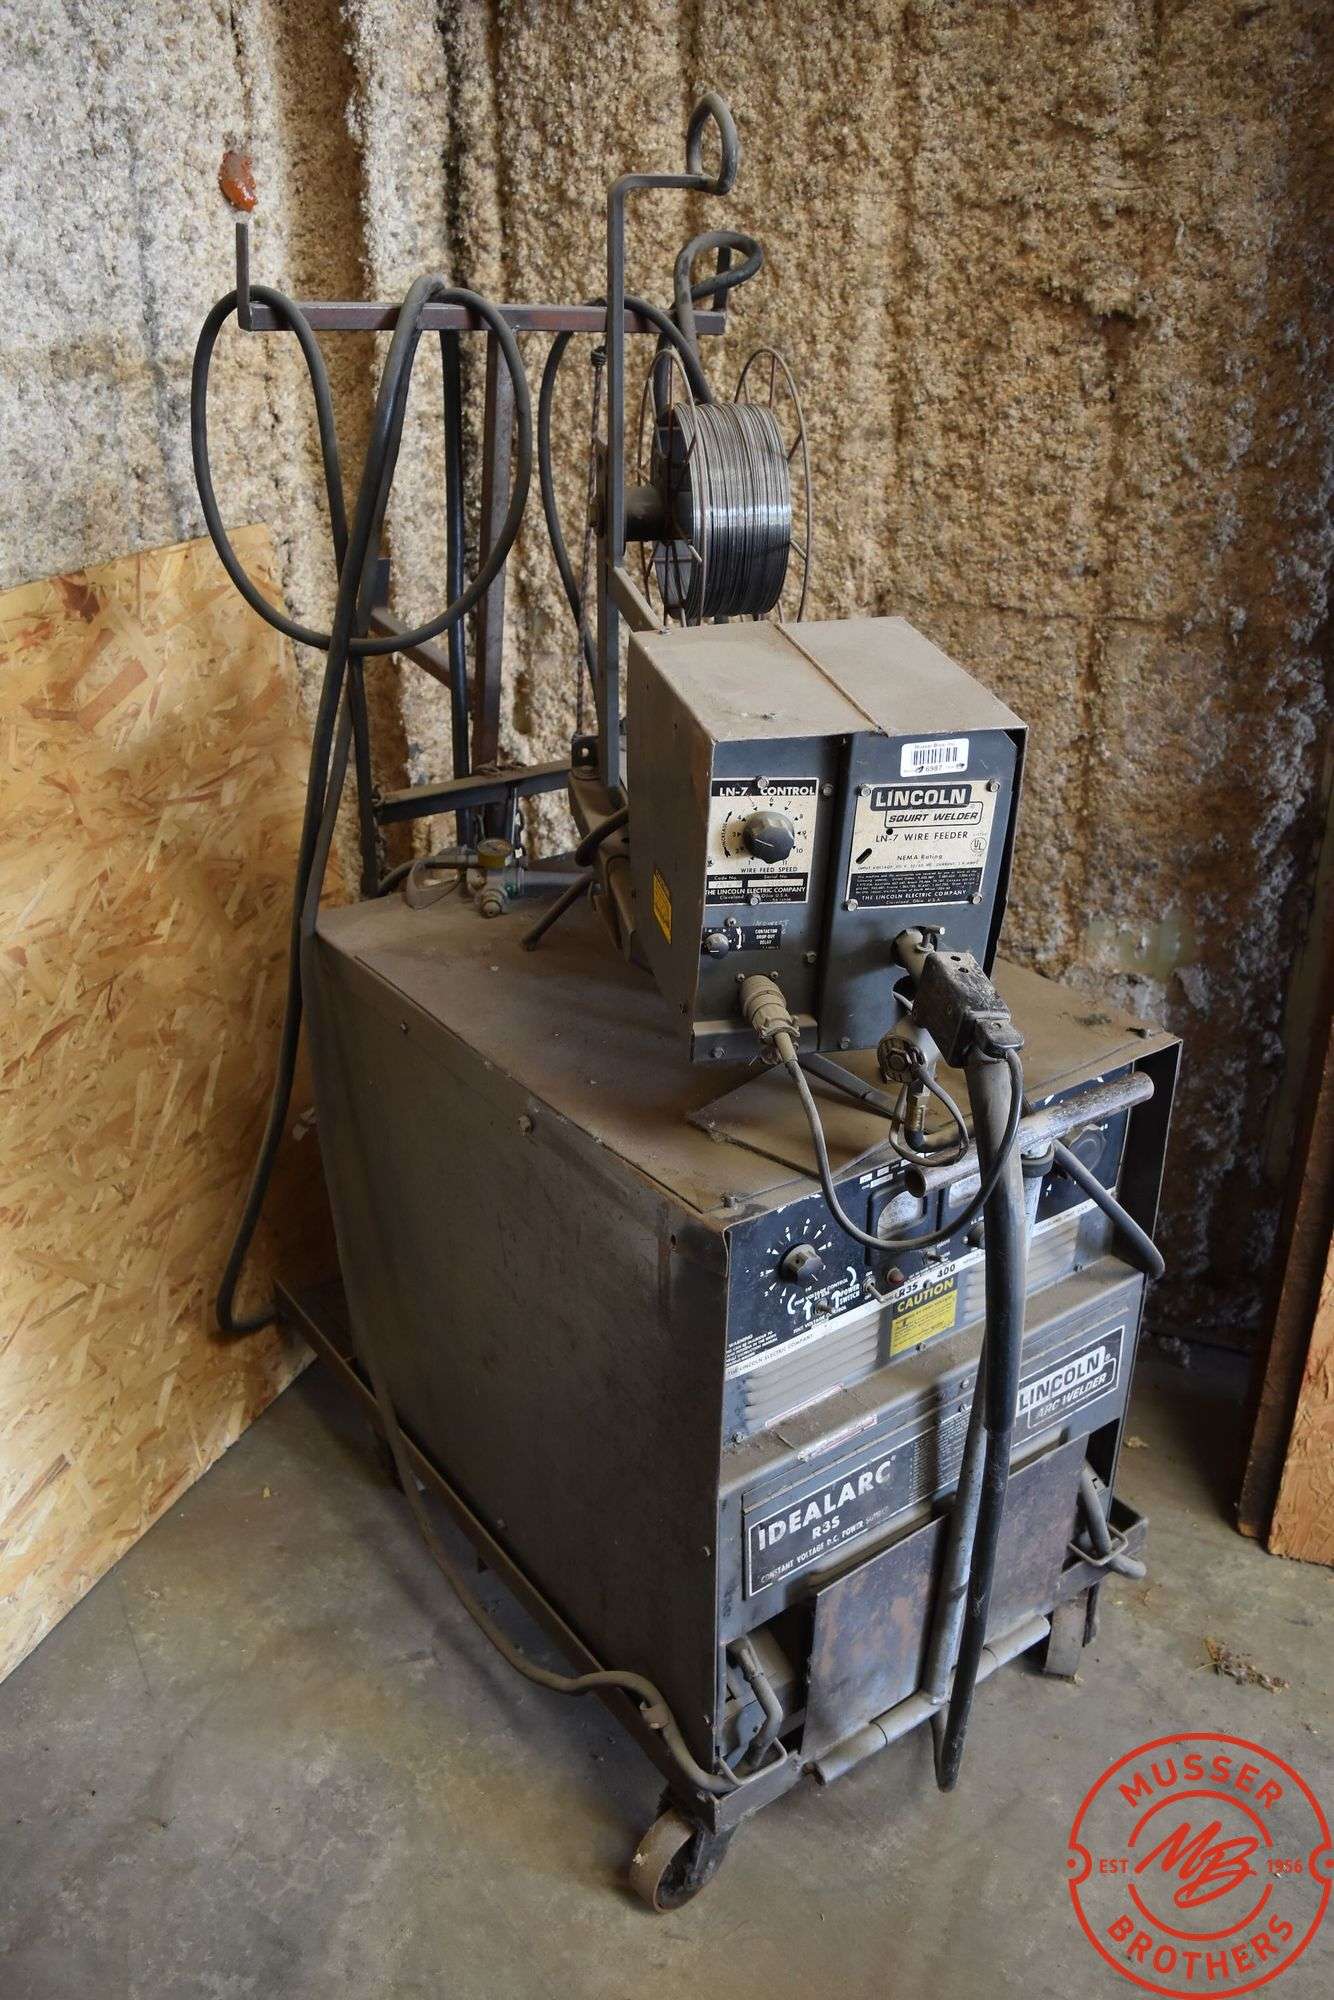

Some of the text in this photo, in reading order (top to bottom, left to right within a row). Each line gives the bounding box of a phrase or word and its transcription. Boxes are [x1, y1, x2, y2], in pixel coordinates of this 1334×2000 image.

[719, 786, 815, 796] LN-7 CONTROL
[875, 788, 967, 807] LINCOLN
[888, 811, 979, 823] SQUIRT WELDER
[875, 834, 899, 843] LN-7
[903, 832, 929, 841] WIRE
[934, 831, 968, 840] FEEDER
[774, 886, 806, 894] COMPANY
[840, 1283, 860, 1297] POWER
[840, 1290, 860, 1305] SWITCH
[896, 1277, 955, 1313] CAUTION
[787, 1333, 814, 1350] COMPANY
[1019, 1352, 1100, 1411] LINCOLN
[1038, 1373, 1107, 1418] ARC WELDER
[757, 1460, 892, 1550] IDEALARC
[812, 1515, 840, 1540] R3S
[760, 1559, 794, 1583] CONSTANT
[796, 1541, 824, 1564] VOLTAGE
[826, 1533, 840, 1548] D.C.
[841, 1519, 864, 1538] POWER
